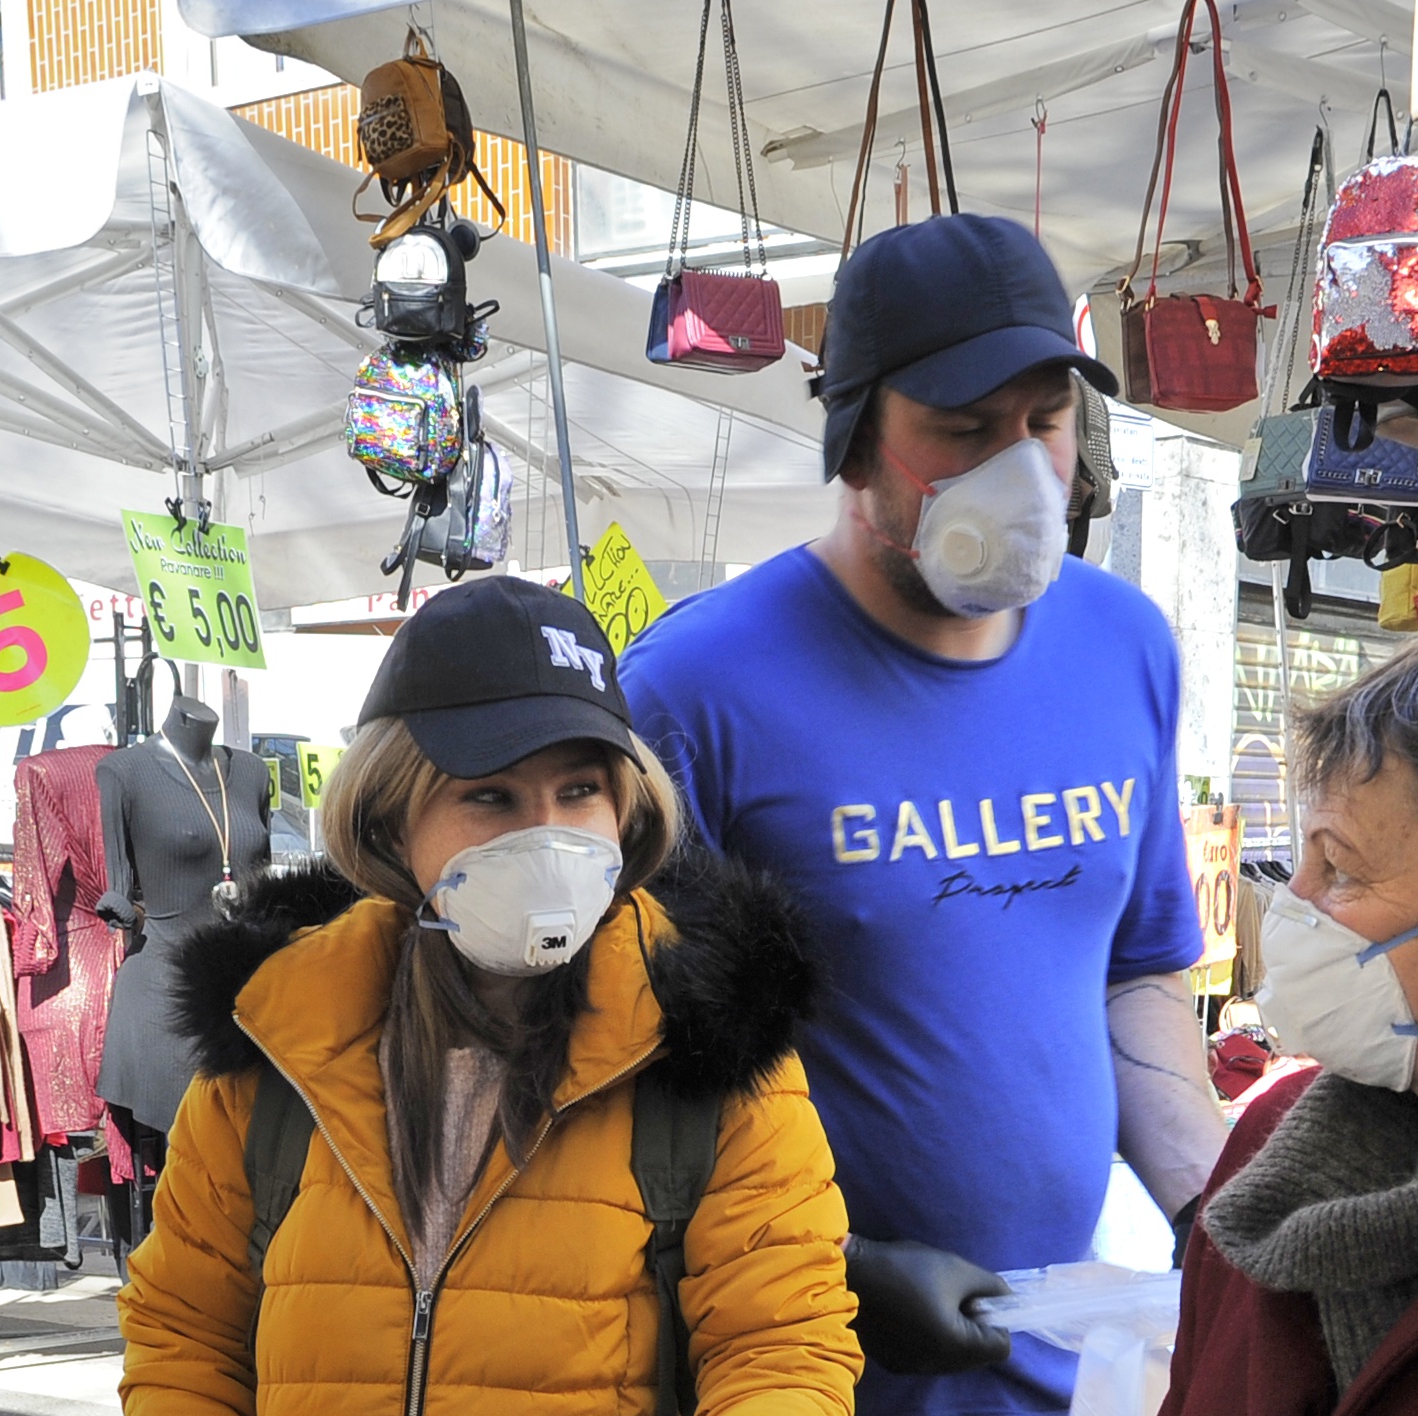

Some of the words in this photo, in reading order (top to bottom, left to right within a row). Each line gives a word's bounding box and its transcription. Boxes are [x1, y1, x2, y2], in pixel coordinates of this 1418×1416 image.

[130, 518, 165, 553] New
[171, 526, 246, 564] Collection
[188, 587, 259, 658] 5,00
[541, 626, 605, 692] NY
[831, 778, 1136, 864] GALLERY
[541, 935, 567, 950] 3M
